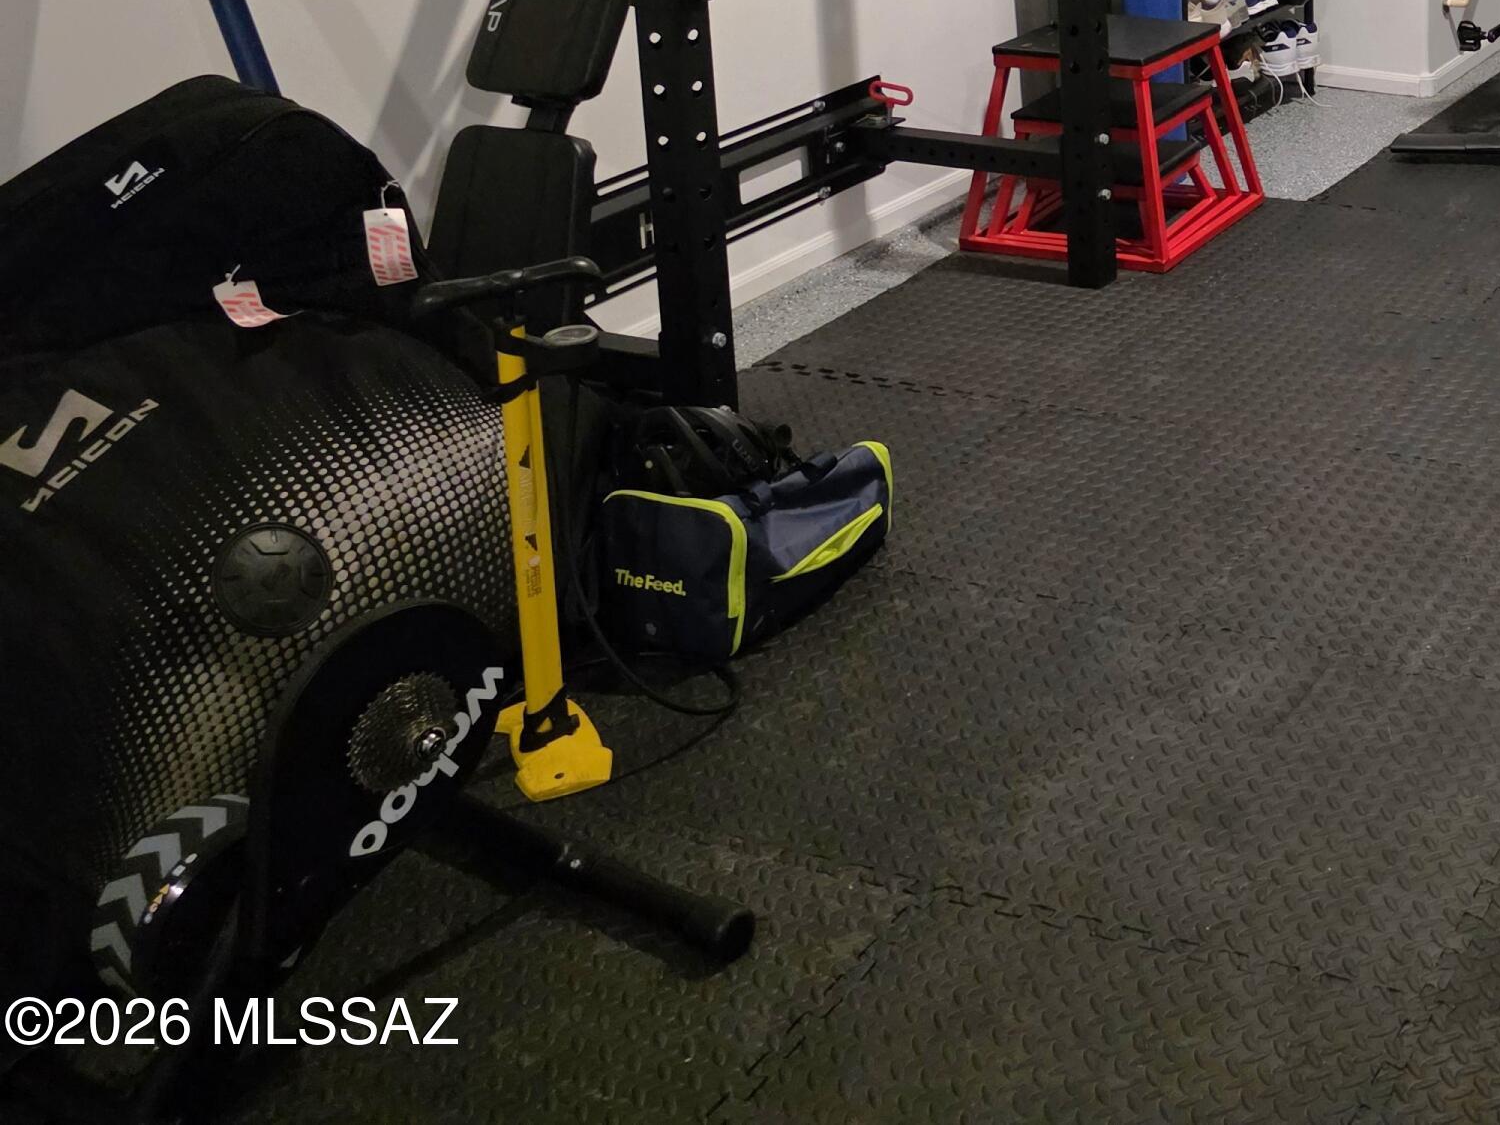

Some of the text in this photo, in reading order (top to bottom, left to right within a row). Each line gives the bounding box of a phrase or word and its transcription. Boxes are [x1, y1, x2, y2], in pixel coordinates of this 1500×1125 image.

[111, 167, 165, 209] SCICON
[20, 398, 160, 513] SCICON
[615, 568, 687, 597] The Feed.
